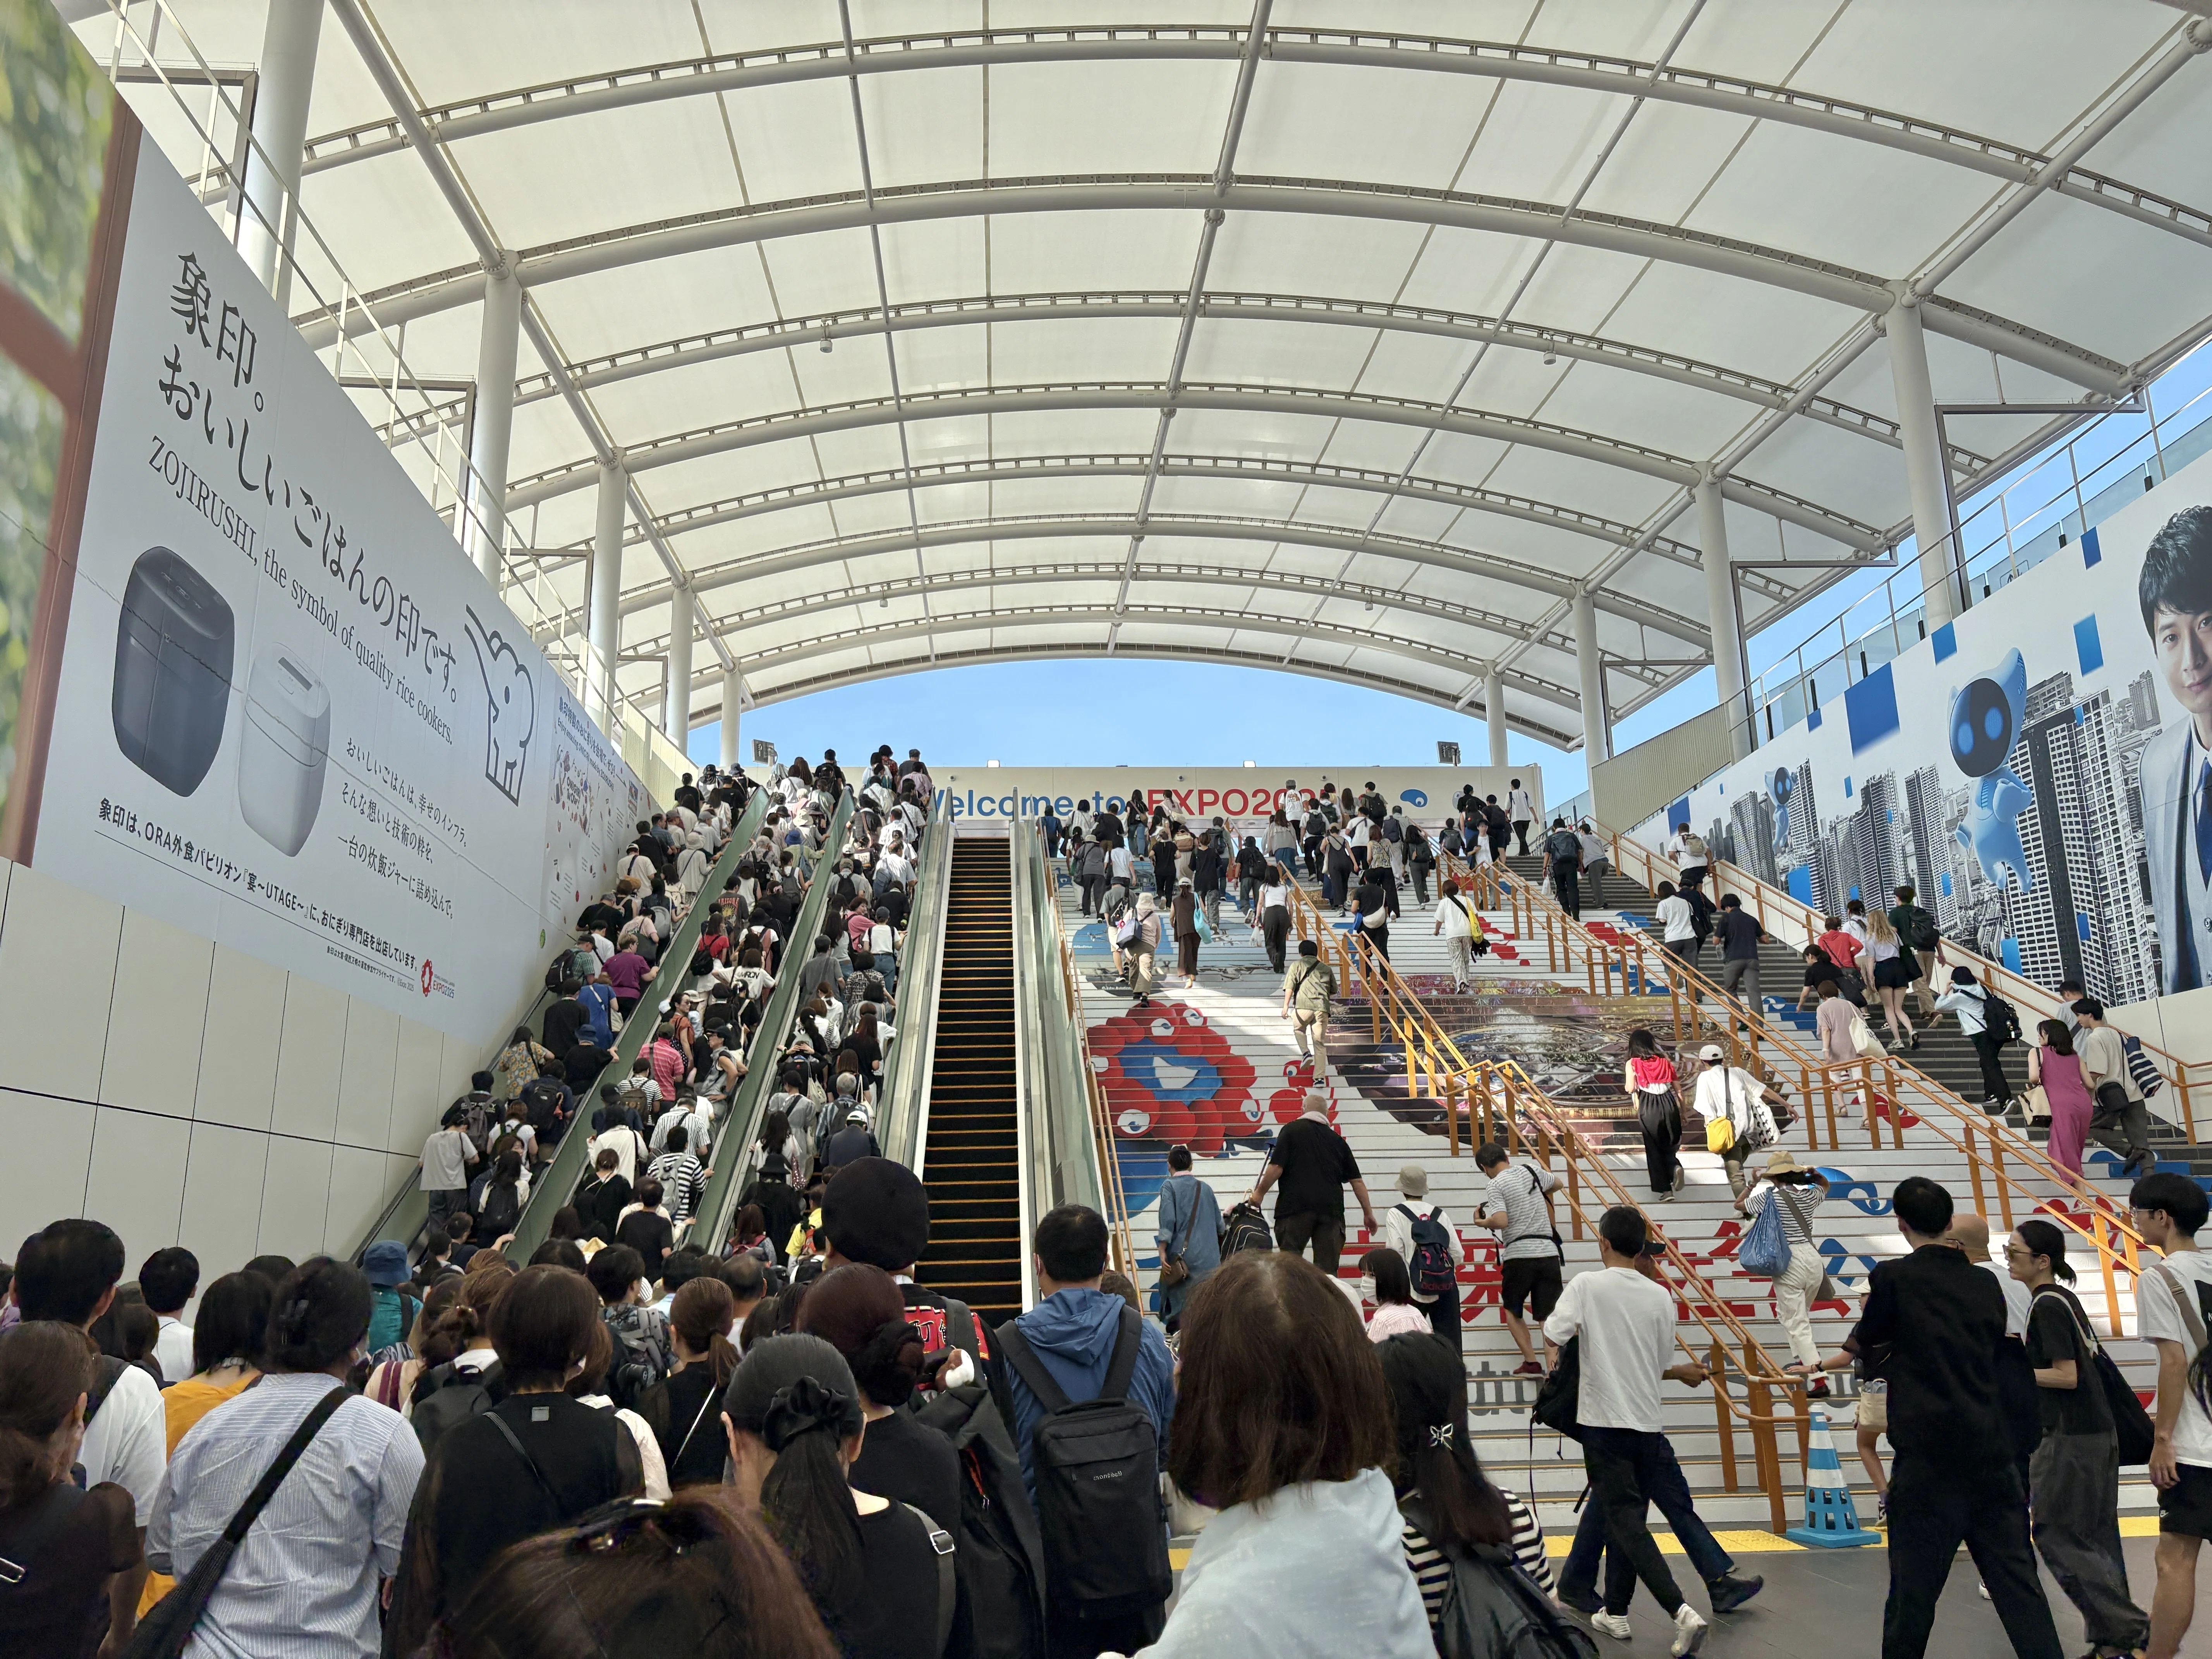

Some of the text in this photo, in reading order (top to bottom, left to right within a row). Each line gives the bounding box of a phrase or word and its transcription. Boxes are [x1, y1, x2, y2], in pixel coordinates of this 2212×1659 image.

[170, 251, 264, 412] 象印。
[159, 344, 456, 702] おいしいごはんの印です。
[149, 435, 452, 745] ZOJIRUSHI, the symbol of quality rice cookers.
[342, 783, 433, 864] そんな想いと技術の粋を、
[347, 737, 466, 847] おいしいごはんは、幸せのインフラ。
[1092, 791, 1125, 816] to
[338, 835, 453, 919] 一台の炊飯ジャーに詰め込んで。
